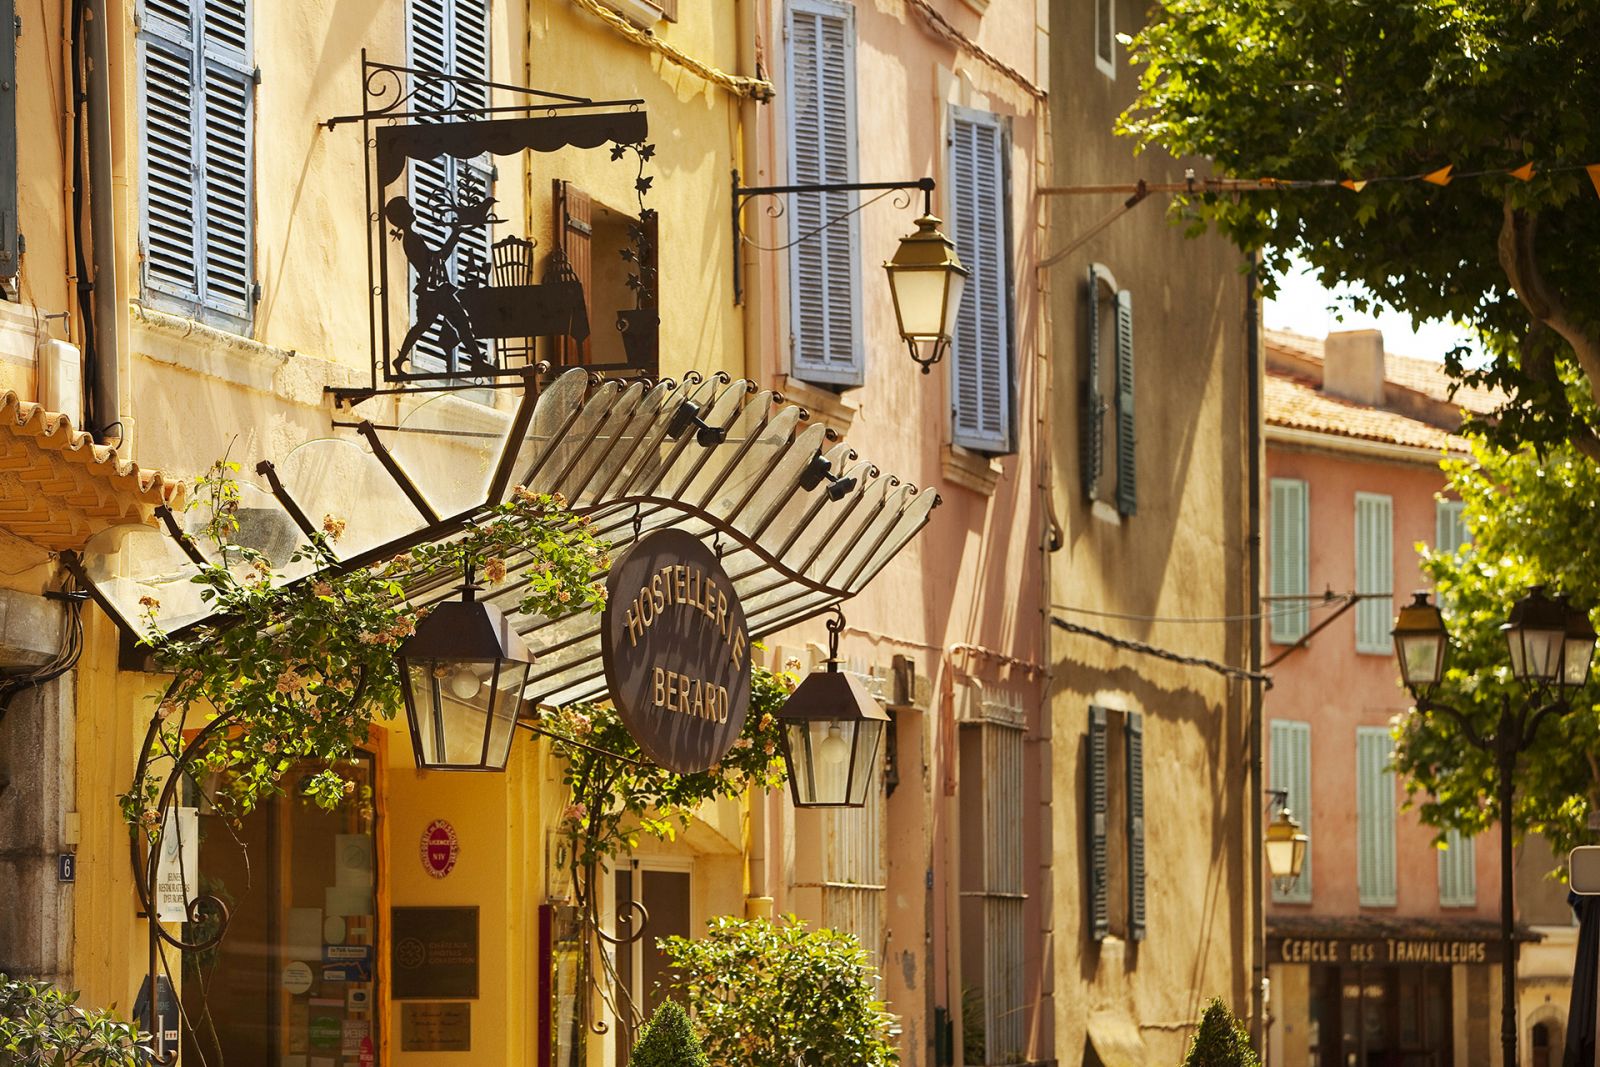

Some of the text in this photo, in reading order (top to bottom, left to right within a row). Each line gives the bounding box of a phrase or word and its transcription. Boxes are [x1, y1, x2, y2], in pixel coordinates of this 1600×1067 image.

[625, 564, 746, 672] HOSTELLERIE
[652, 666, 729, 725] BERARD
[64, 858, 71, 878] 6
[1281, 938, 1486, 962] CERCLE DES TRAVAILLEURS
